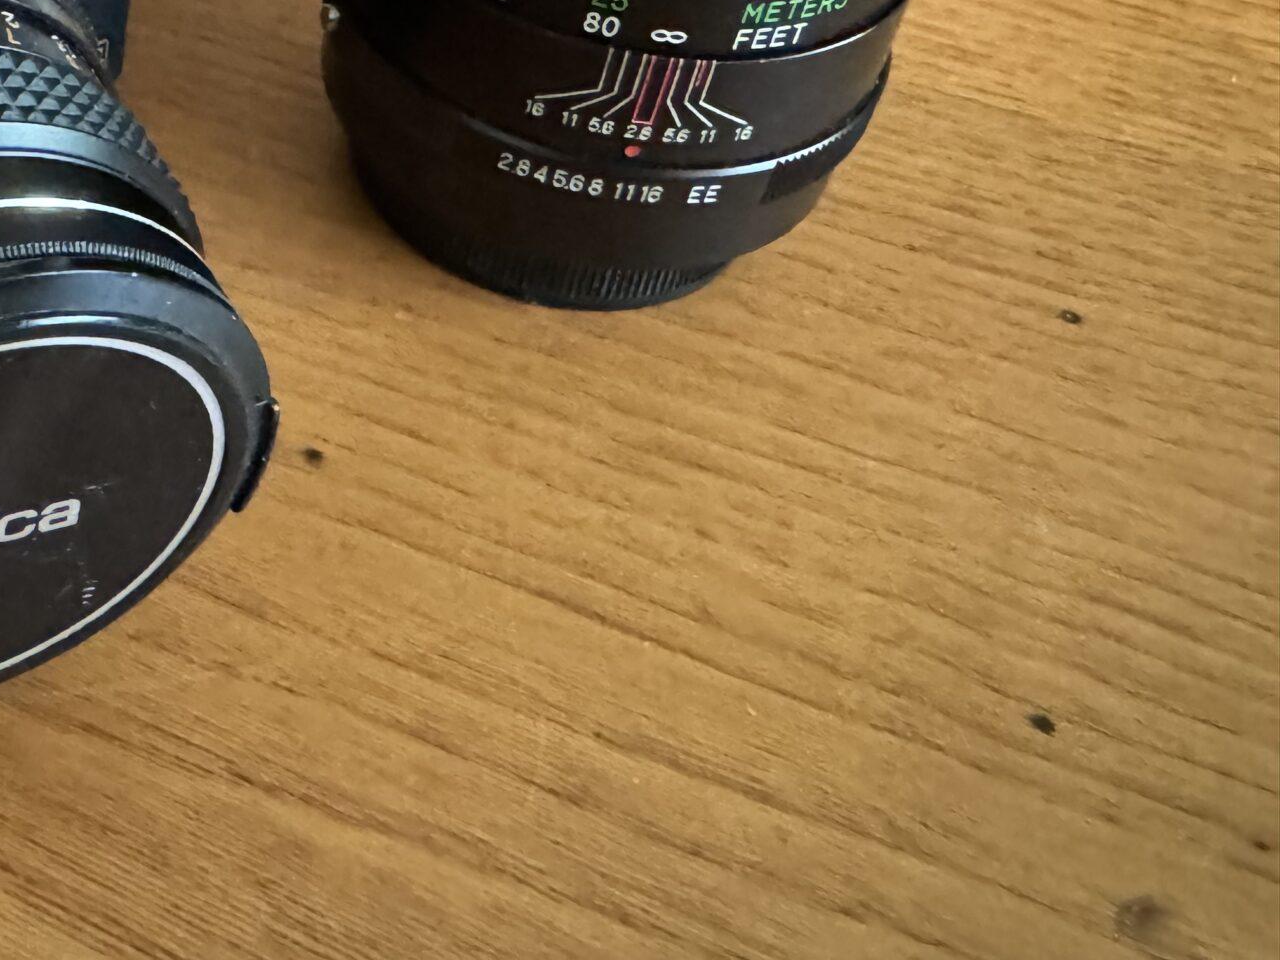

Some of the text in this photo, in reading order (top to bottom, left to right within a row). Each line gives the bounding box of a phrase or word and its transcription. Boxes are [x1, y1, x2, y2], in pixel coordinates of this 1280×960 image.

[1, 11, 21, 29] 2
[583, 11, 621, 38] 80
[732, 22, 808, 51] FEET
[525, 99, 545, 117] 16
[561, 111, 578, 127] 11
[588, 117, 615, 136] 5.6
[662, 127, 691, 143] 5.6
[699, 128, 717, 144] 11
[734, 125, 755, 141] 16
[497, 152, 722, 204] 2.8 4 5.6 8 11 16 EE
